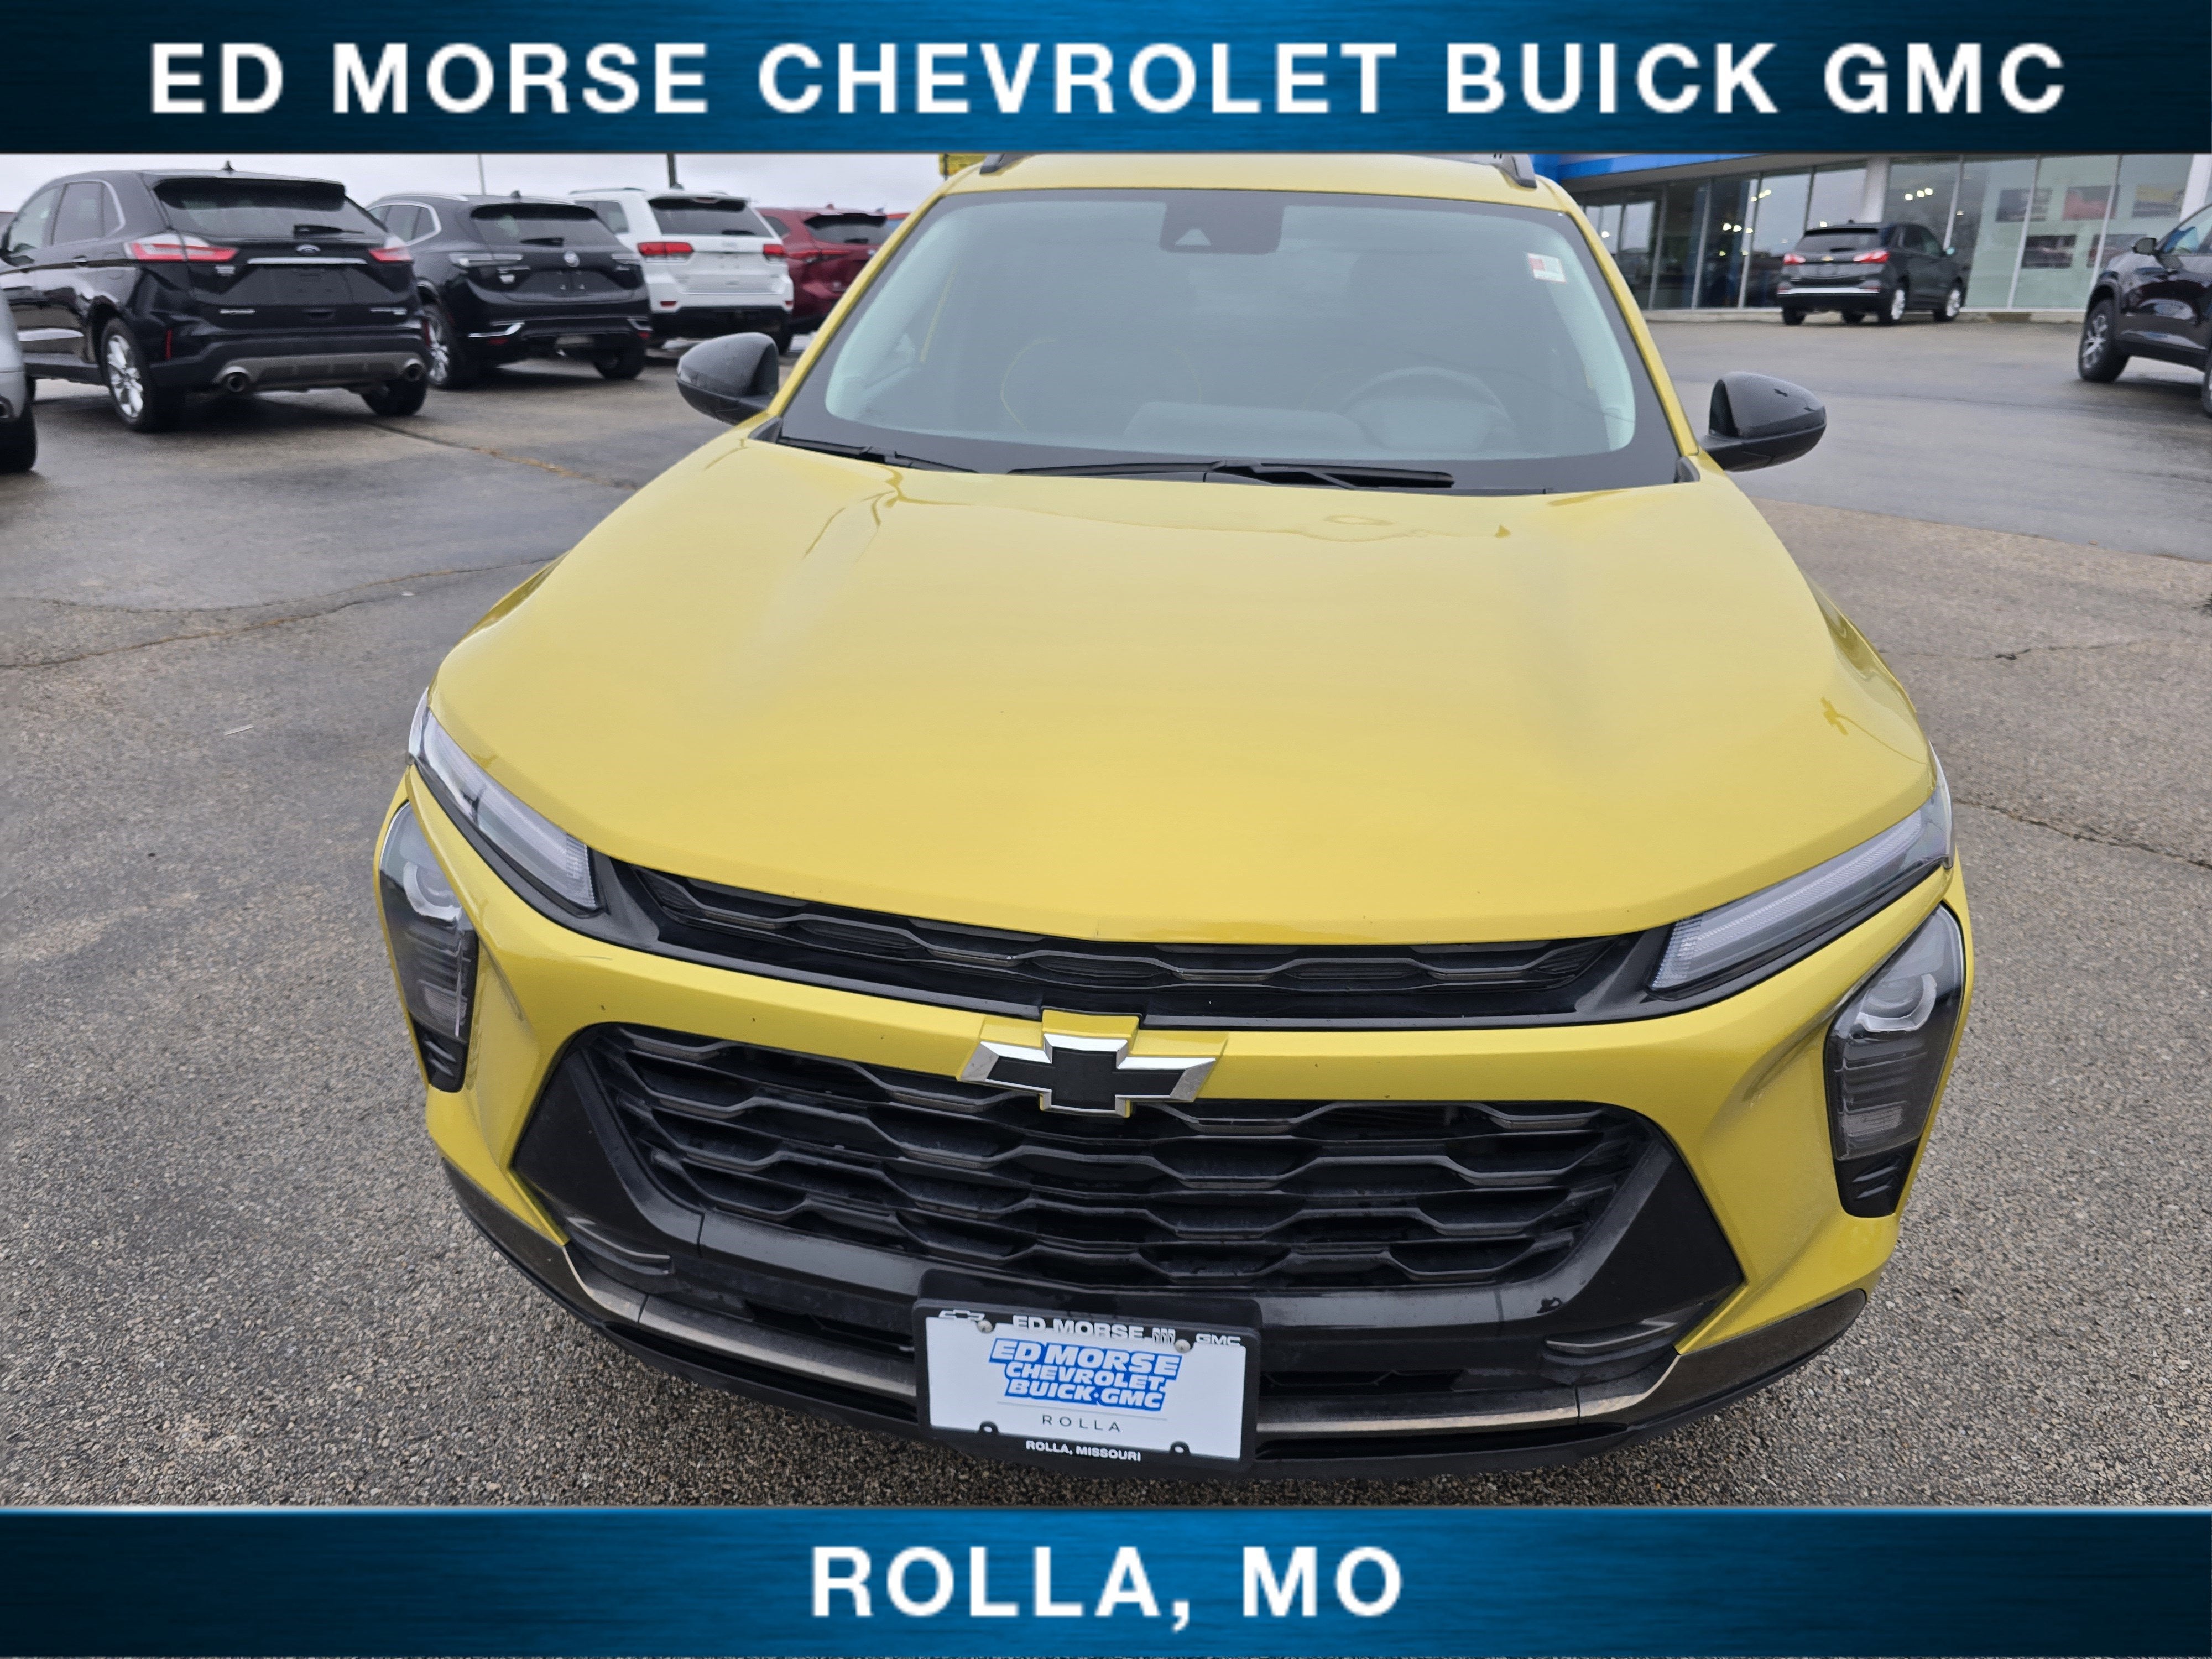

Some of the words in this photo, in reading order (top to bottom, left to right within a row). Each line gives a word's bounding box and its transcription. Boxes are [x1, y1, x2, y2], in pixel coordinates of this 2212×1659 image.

[1013, 1314, 1046, 1330] ED
[1053, 1318, 1144, 1340] MORSE
[1196, 1333, 1241, 1345] GMC
[991, 1339, 1042, 1362] ED
[1044, 1344, 1180, 1376] MORSE
[1042, 1414, 1121, 1432] ROLLA
[1025, 1439, 1073, 1455] ROLLA,
[1076, 1445, 1141, 1462] MISSOURI
